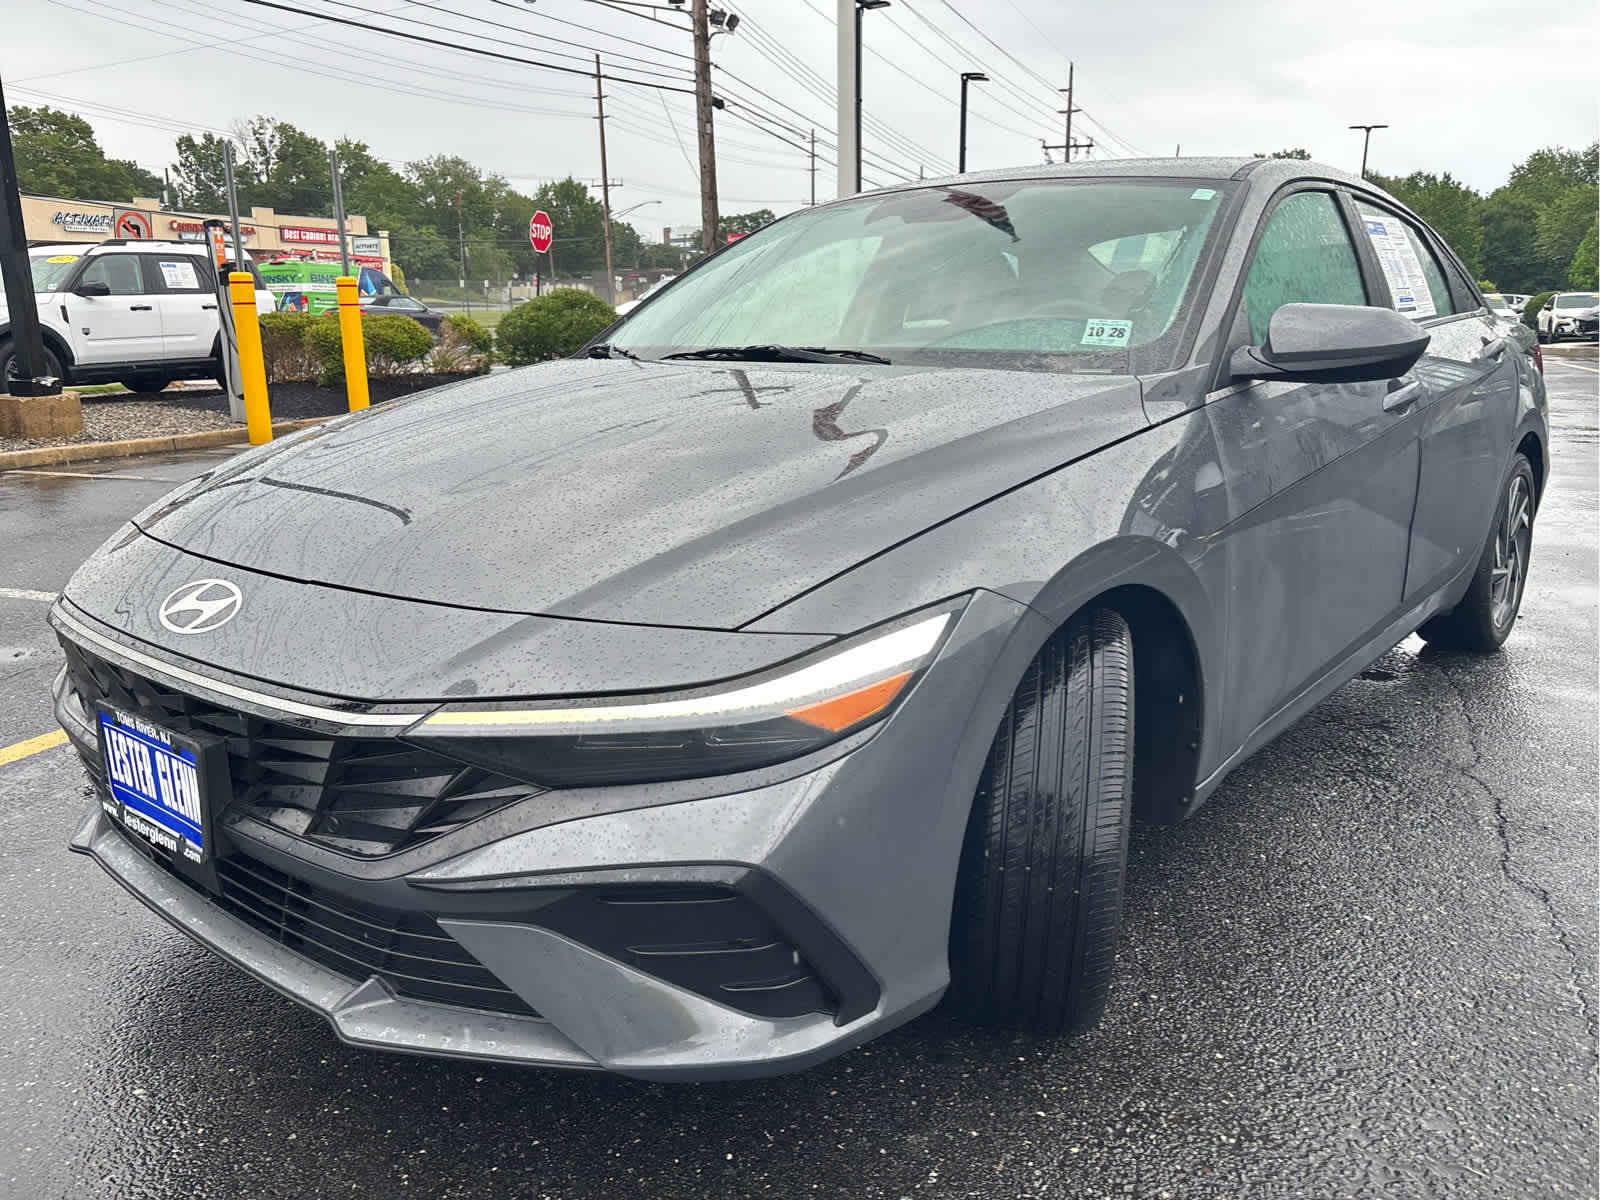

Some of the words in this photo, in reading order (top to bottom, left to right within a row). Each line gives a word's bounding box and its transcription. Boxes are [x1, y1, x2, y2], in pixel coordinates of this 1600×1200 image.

[532, 223, 550, 240] STOP
[310, 273, 336, 284] BINS
[1087, 326, 1105, 337] 10
[1108, 327, 1126, 338] 28
[115, 710, 136, 730] TOMS
[135, 718, 160, 740] RIVER,
[159, 731, 171, 746] NJ
[103, 726, 158, 800] LESTER
[154, 750, 202, 824] GLENN
[124, 810, 177, 853] lesterglenn
